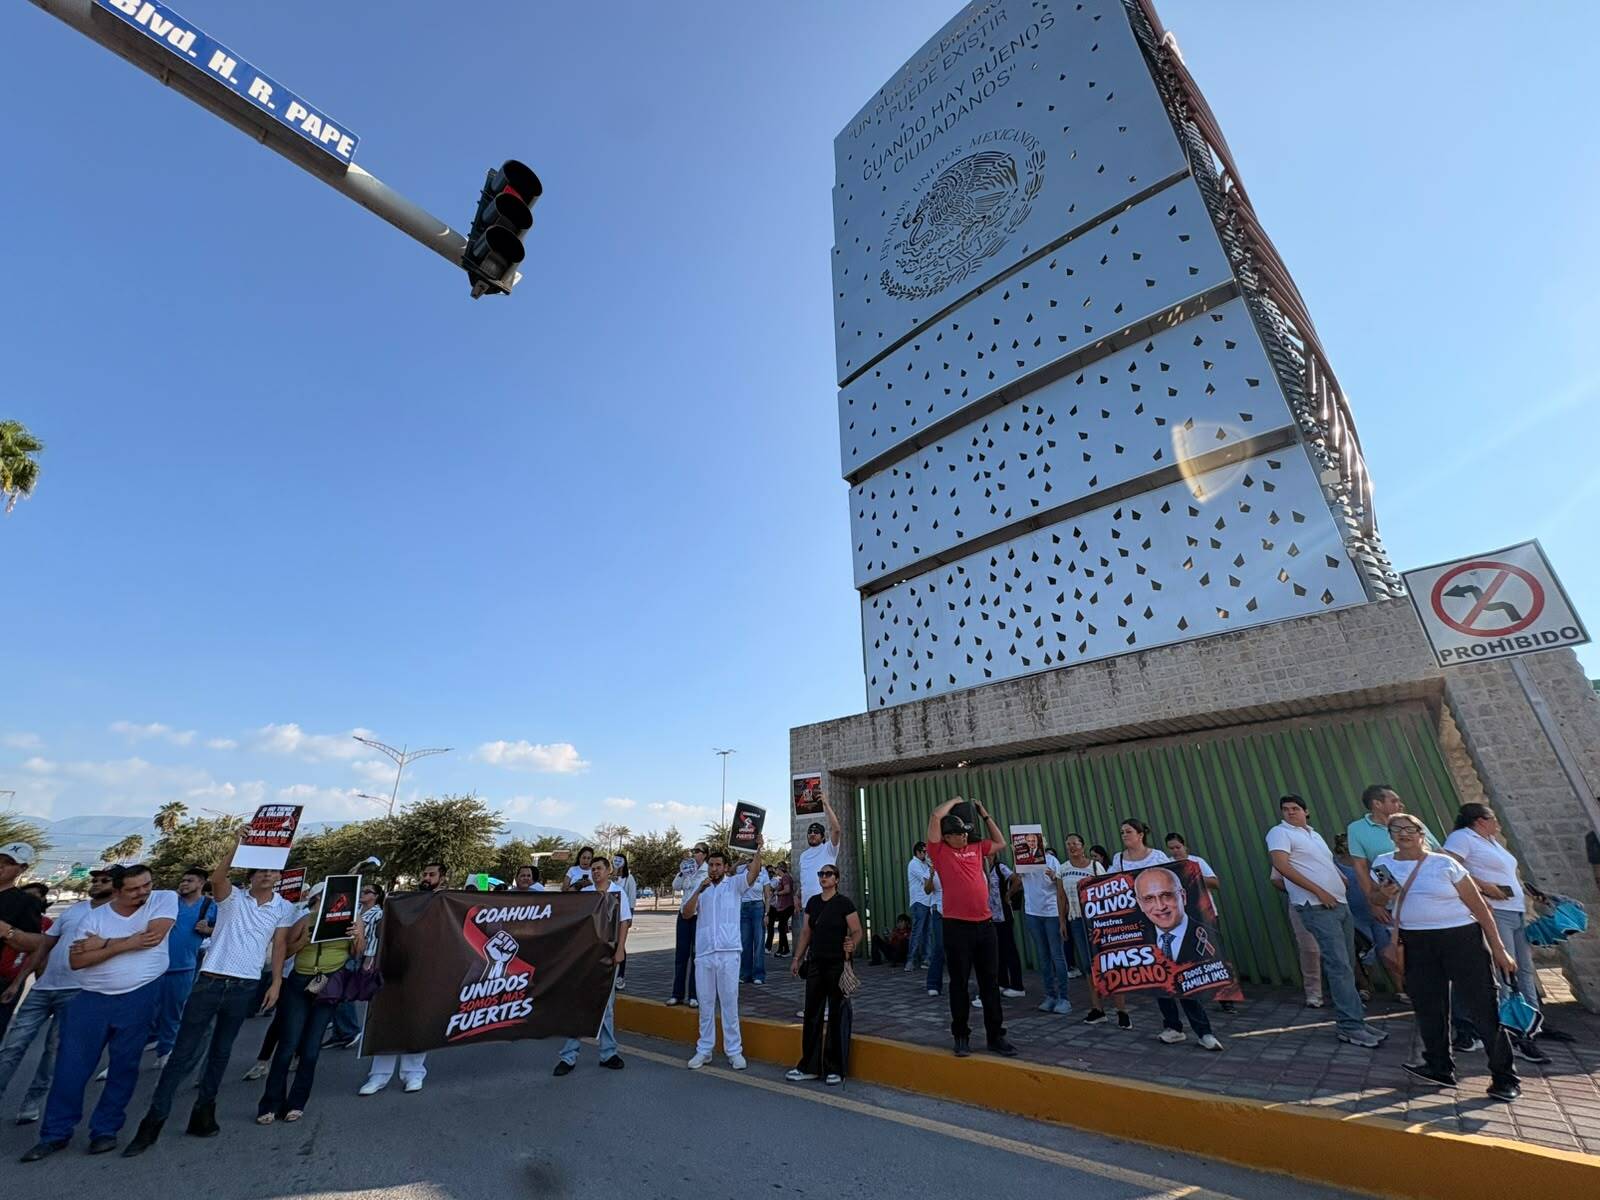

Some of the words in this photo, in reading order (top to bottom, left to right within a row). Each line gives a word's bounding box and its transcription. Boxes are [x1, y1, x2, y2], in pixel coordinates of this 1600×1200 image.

[109, 0, 197, 58] Blvd.
[208, 50, 237, 84] H.
[248, 77, 275, 109] R.
[285, 101, 354, 157] PAPE
[888, 67, 938, 122] PUEDE
[943, 10, 1008, 71] EXISTIR
[863, 116, 926, 181] CUANDO
[932, 80, 965, 119] HAY
[972, 12, 1055, 85] BUENOS
[894, 63, 1016, 174] CIUDADANOS"
[912, 145, 962, 192] UNIDOS
[969, 128, 1040, 151] MEXICANOS
[1440, 626, 1580, 662] PROHIBIDO
[1087, 878, 1129, 902] FUERA
[475, 904, 552, 924] COAHUILA
[1084, 891, 1137, 919] OLIVOS
[1092, 928, 1101, 944] 2
[1103, 922, 1139, 935] neuronas
[1093, 917, 1123, 928] Nuestras
[1108, 931, 1143, 943] funcionan
[1100, 946, 1155, 973] IMSS
[459, 972, 529, 1002] UNIDOS
[1105, 965, 1167, 990] DIGNO
[1181, 976, 1211, 993] FAMILIA
[1211, 970, 1229, 982] IMSS
[459, 995, 499, 1014] SOMOS
[502, 989, 526, 1003] MAS
[445, 997, 534, 1036] FUERTES
